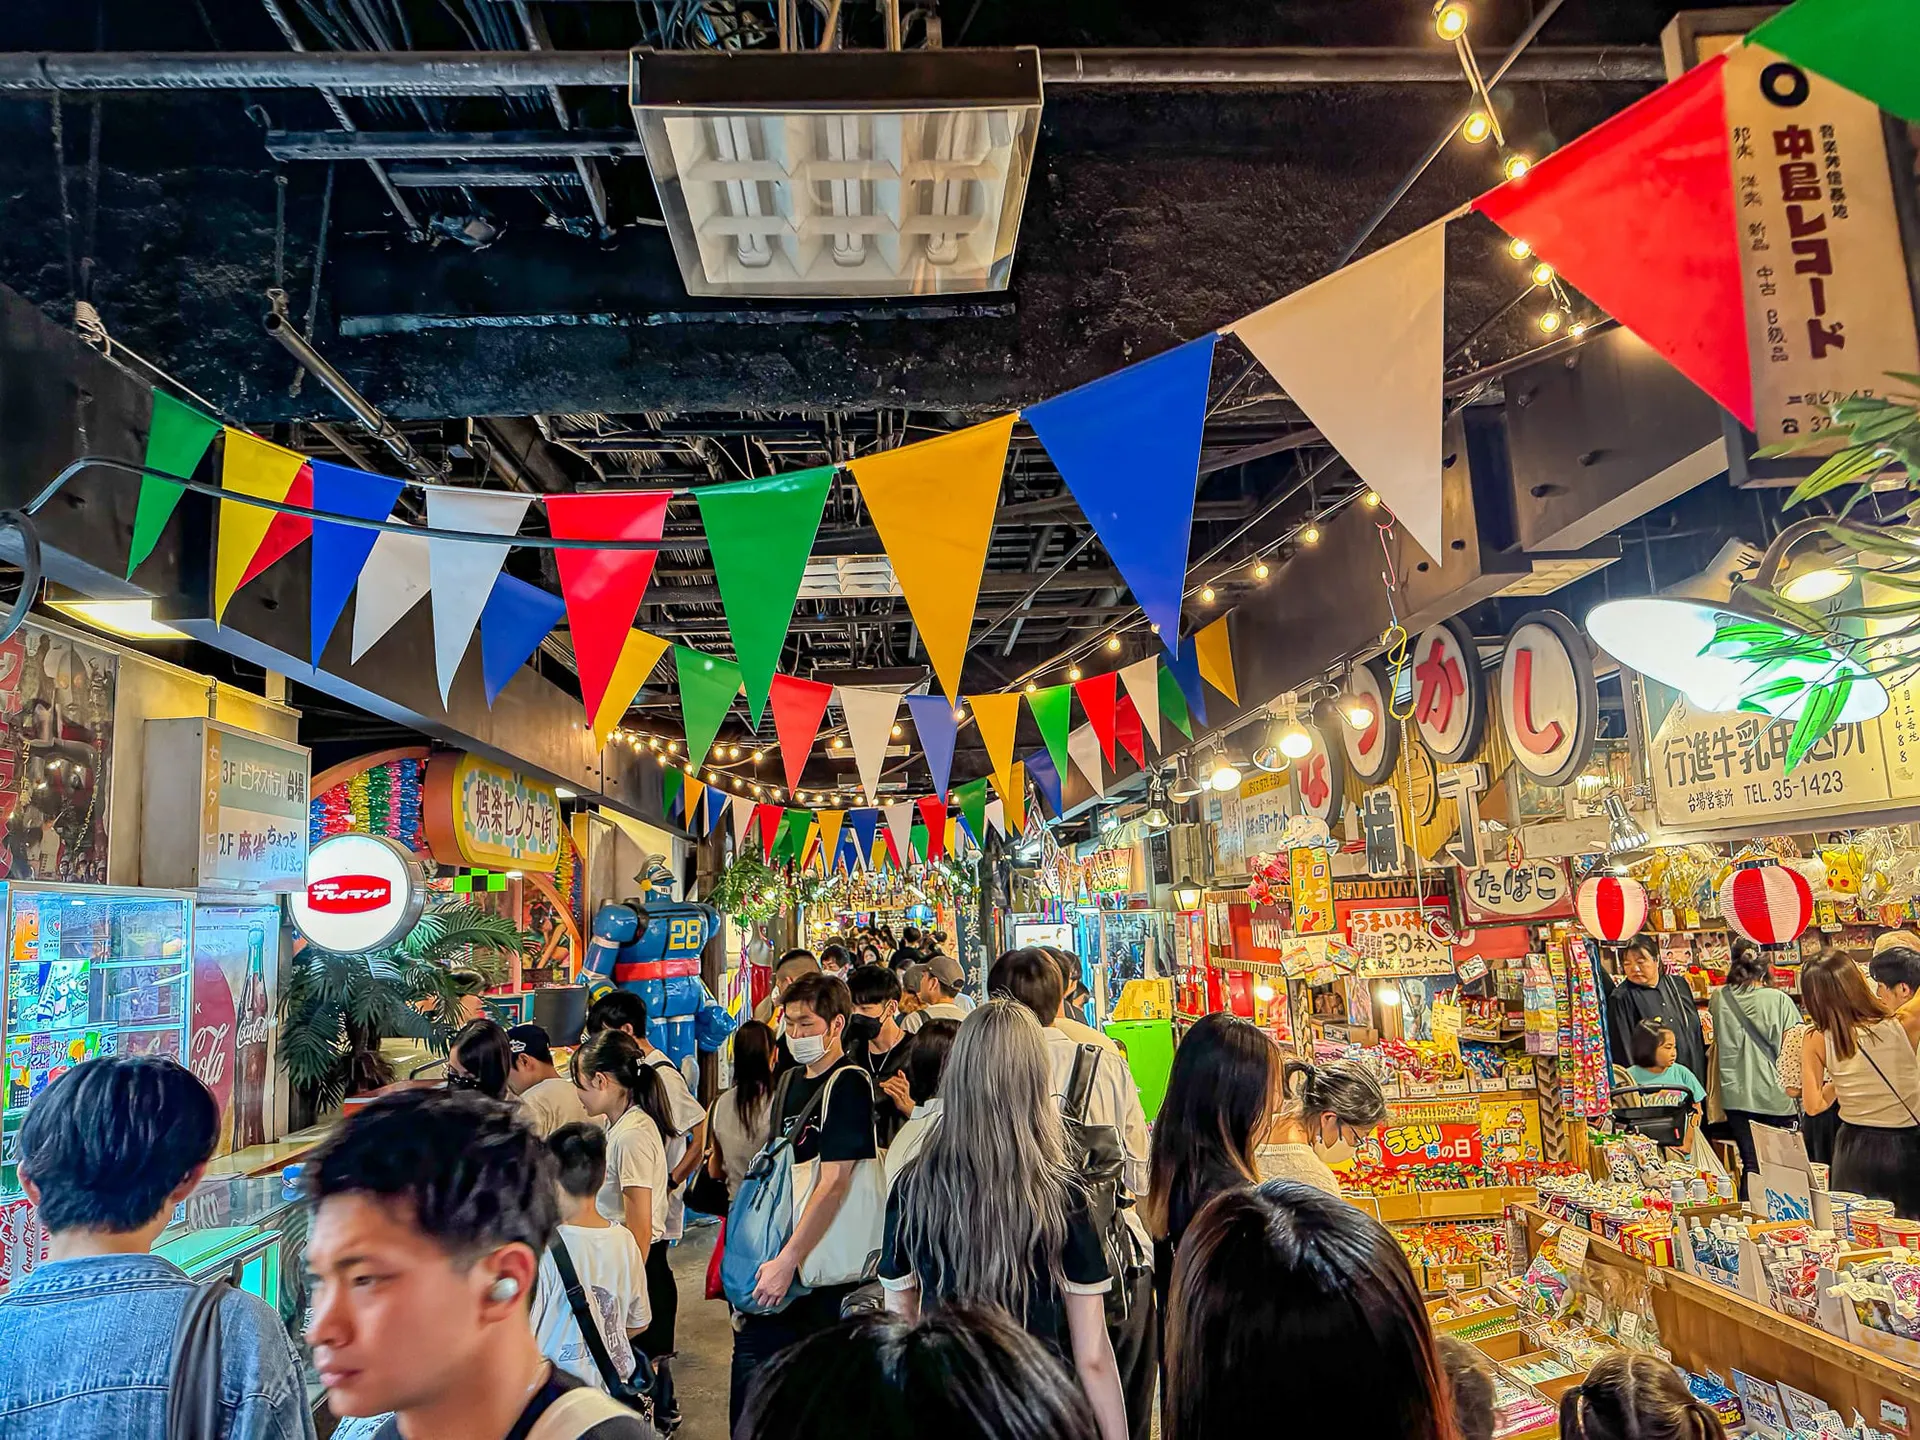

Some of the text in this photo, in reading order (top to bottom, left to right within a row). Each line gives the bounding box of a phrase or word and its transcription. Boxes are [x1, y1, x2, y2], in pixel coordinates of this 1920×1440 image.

[1772, 124, 1845, 359] 中島レコード
[1756, 265, 1776, 296] 中古
[222, 760, 305, 805] 3F ビジネスホテル台場
[205, 744, 220, 865] センタービル
[476, 779, 553, 845] 娯楽センター街
[1687, 788, 1735, 813] 台場営業所
[219, 833, 234, 856] 2F
[238, 830, 267, 862] 麻雀
[1474, 865, 1557, 906] たばこ
[668, 919, 702, 951] 28
[1353, 910, 1423, 933] うまい棒
[1383, 932, 1438, 954] 30本入
[1385, 1124, 1472, 1159] うまい棒の日
